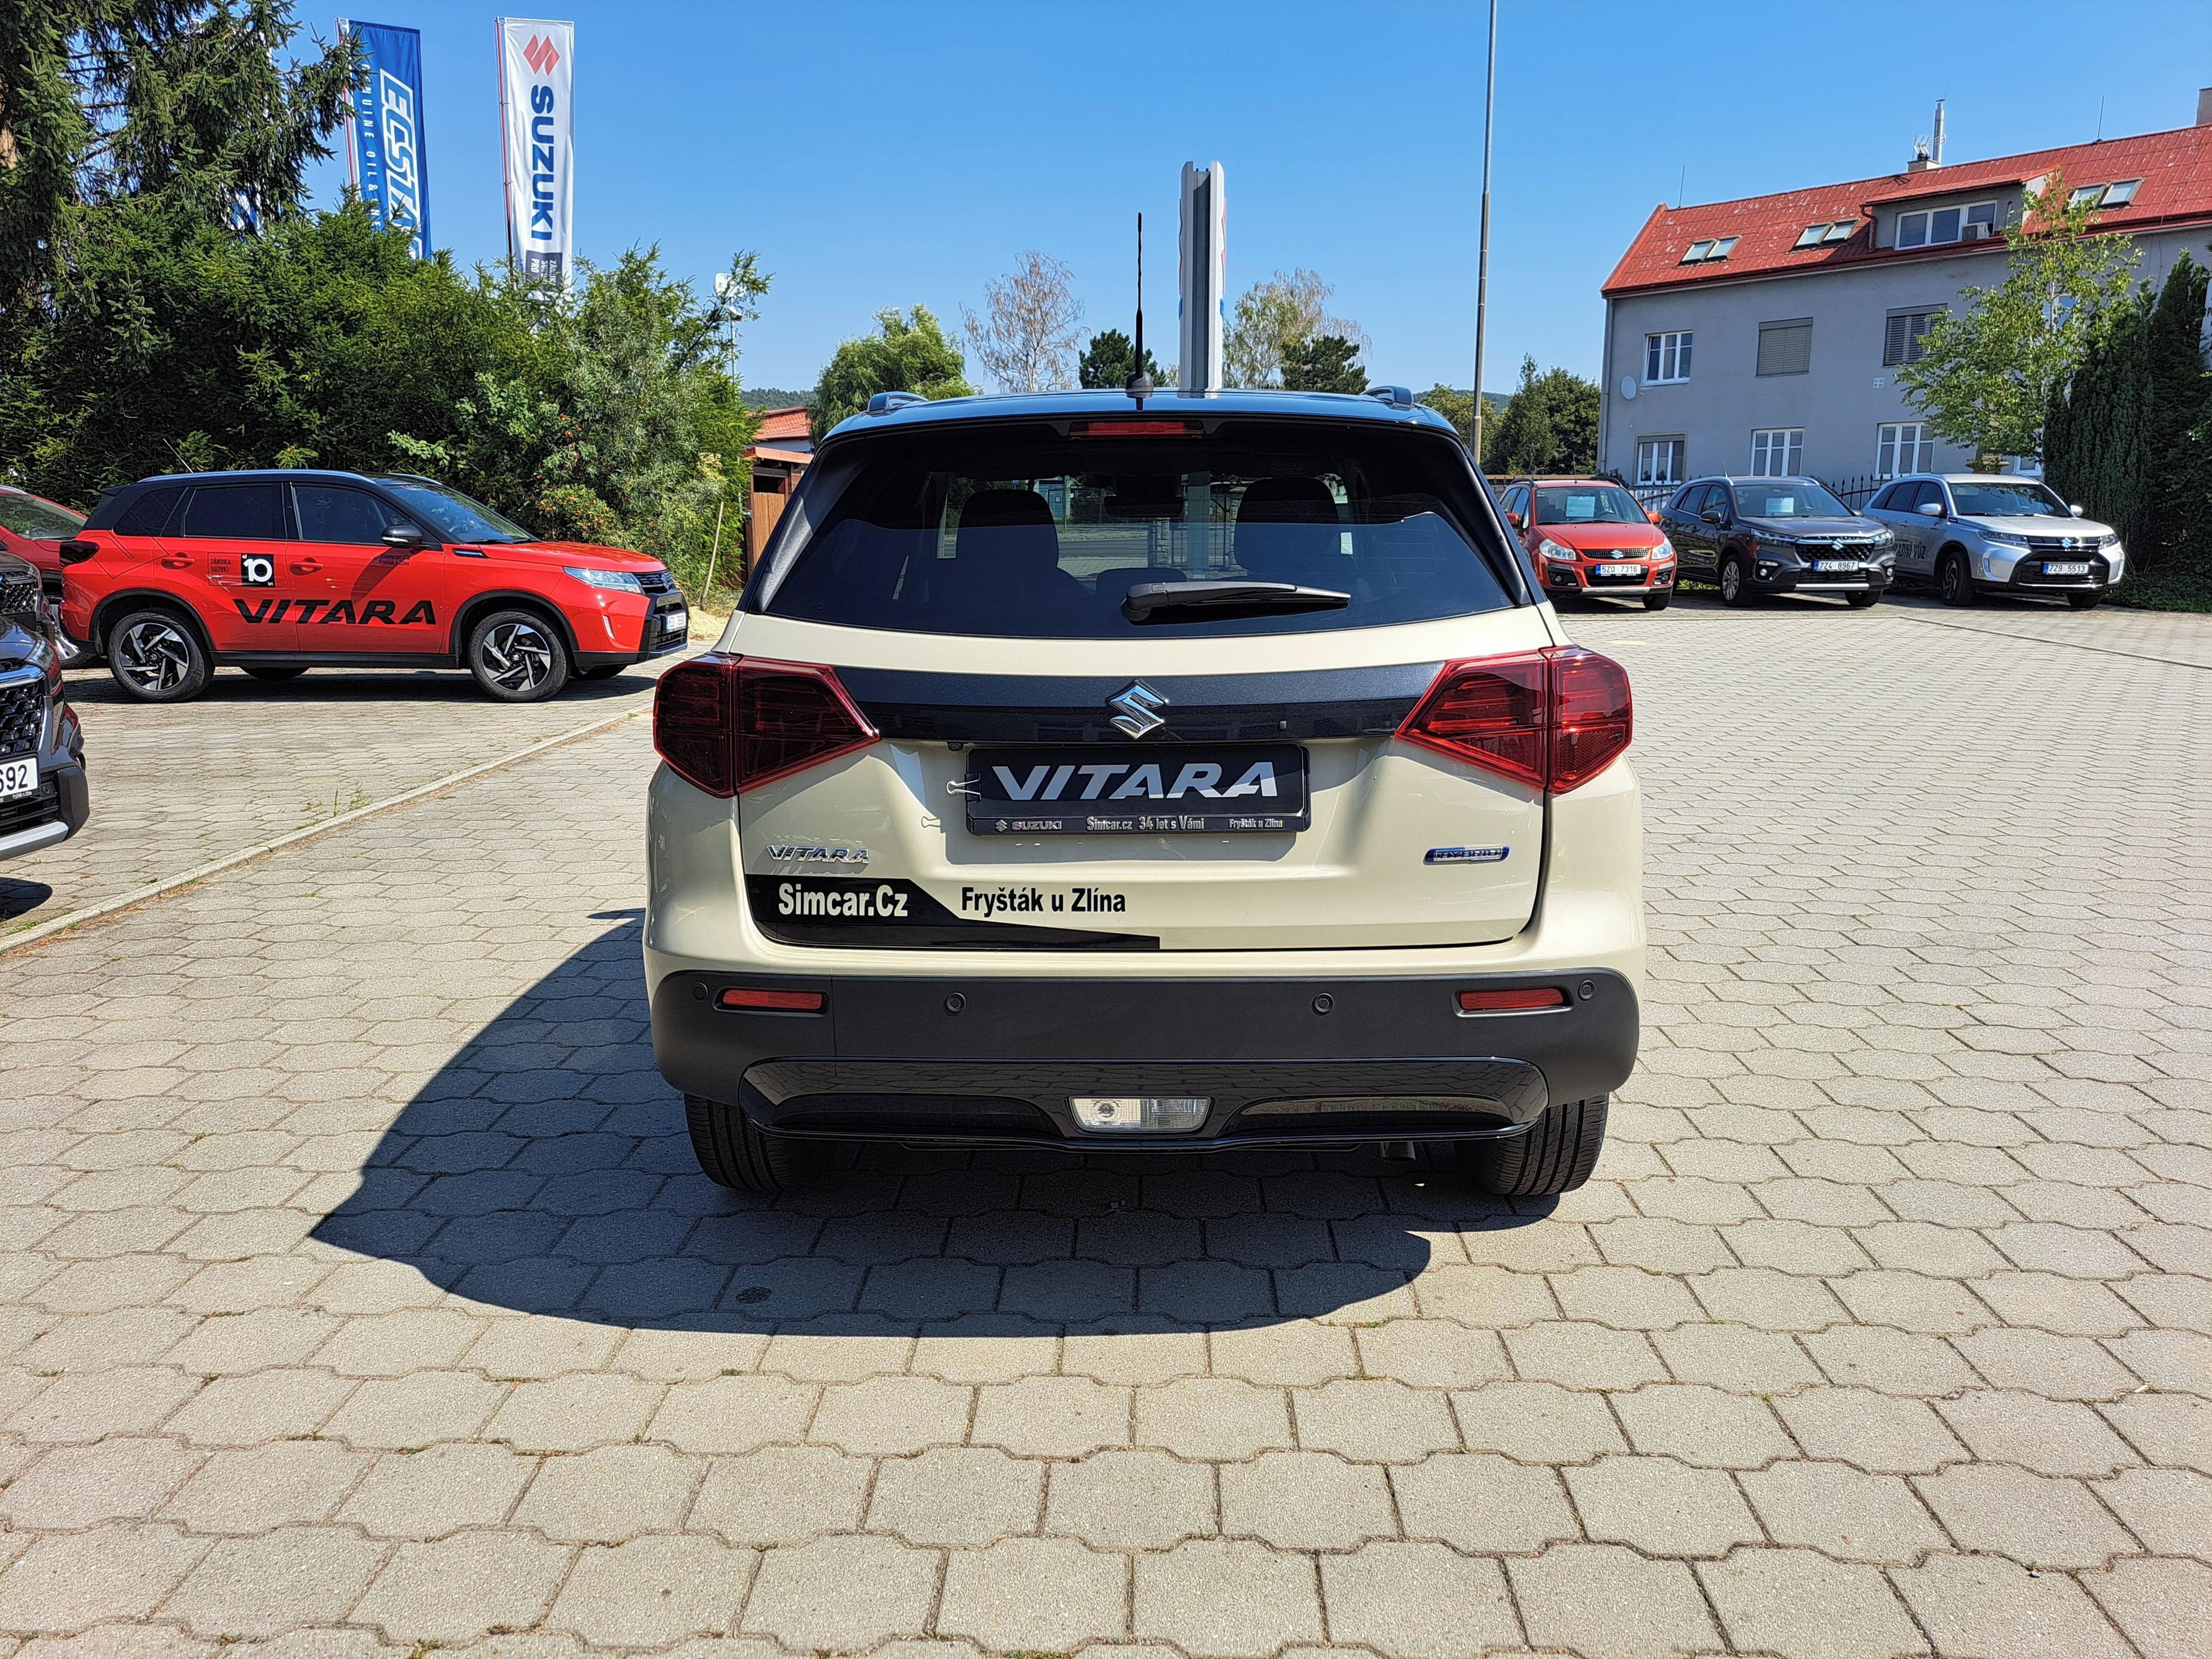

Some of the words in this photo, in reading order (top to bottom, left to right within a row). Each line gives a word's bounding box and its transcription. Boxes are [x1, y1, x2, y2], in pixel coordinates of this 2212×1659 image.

[366, 151, 377, 178] OIL
[531, 84, 554, 241] SUZUKI
[531, 258, 539, 273] PRO
[211, 557, 231, 565] ZÁRUKA
[243, 558, 272, 582] 10
[233, 598, 437, 625] VITARA
[992, 761, 1278, 800] VITARA
[1011, 820, 1062, 830] SUZUKI
[1086, 815, 1132, 831] Simcar.cz
[1137, 815, 1154, 830] 34
[1156, 818, 1169, 830] let
[1170, 819, 1177, 830] s
[1178, 814, 1205, 830] Vámi
[1229, 818, 1256, 828] Fryšták
[1264, 818, 1283, 828] Zlína
[767, 845, 869, 863] VITARA
[778, 882, 908, 917] Simcar.Cz
[961, 887, 1043, 918] Fryšták
[1051, 894, 1064, 912] u
[1071, 887, 1126, 913] Zlína
